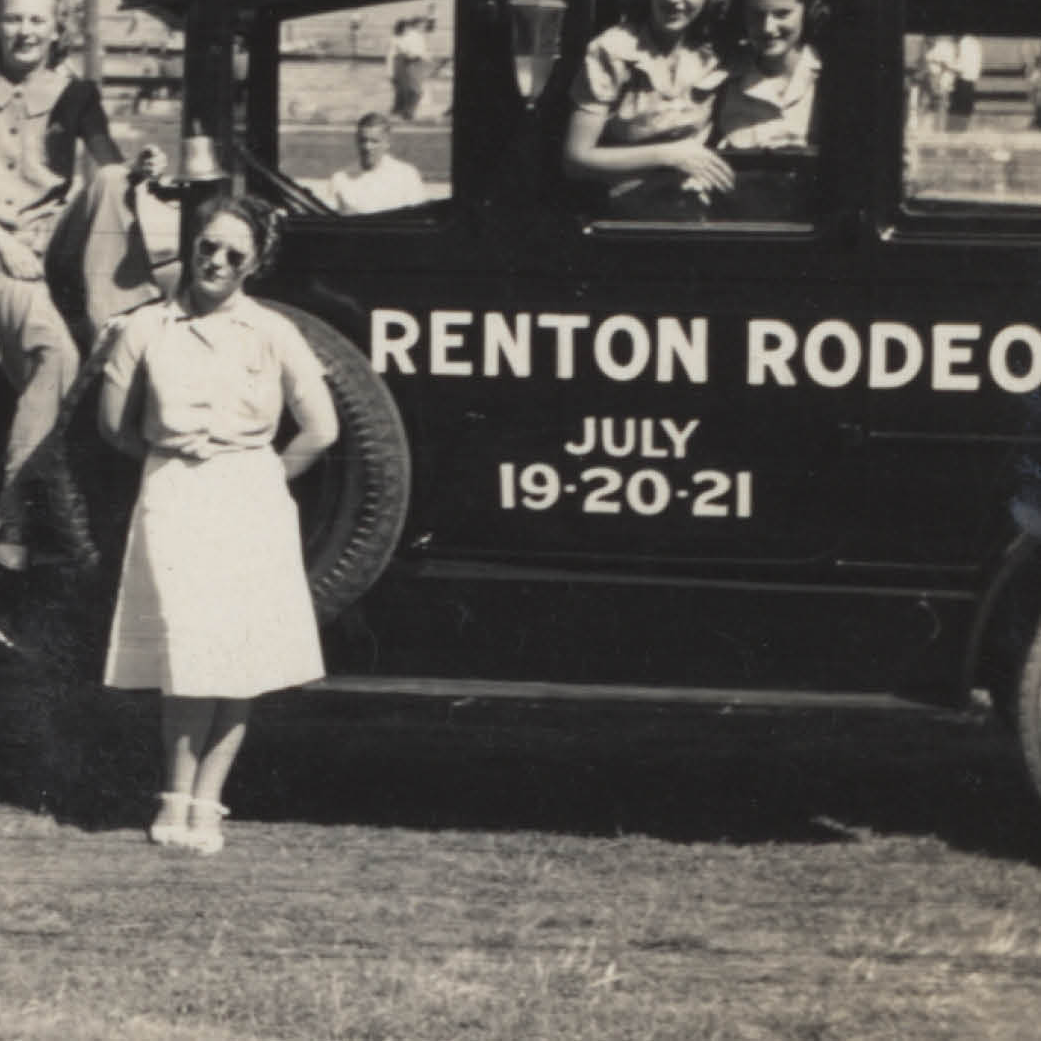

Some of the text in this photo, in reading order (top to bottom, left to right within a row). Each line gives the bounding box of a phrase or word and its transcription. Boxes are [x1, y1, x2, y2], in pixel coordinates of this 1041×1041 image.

[369, 309, 1041, 393] RENTON RODEO
[564, 417, 700, 458] JULY
[499, 463, 752, 518] 19-20-21
